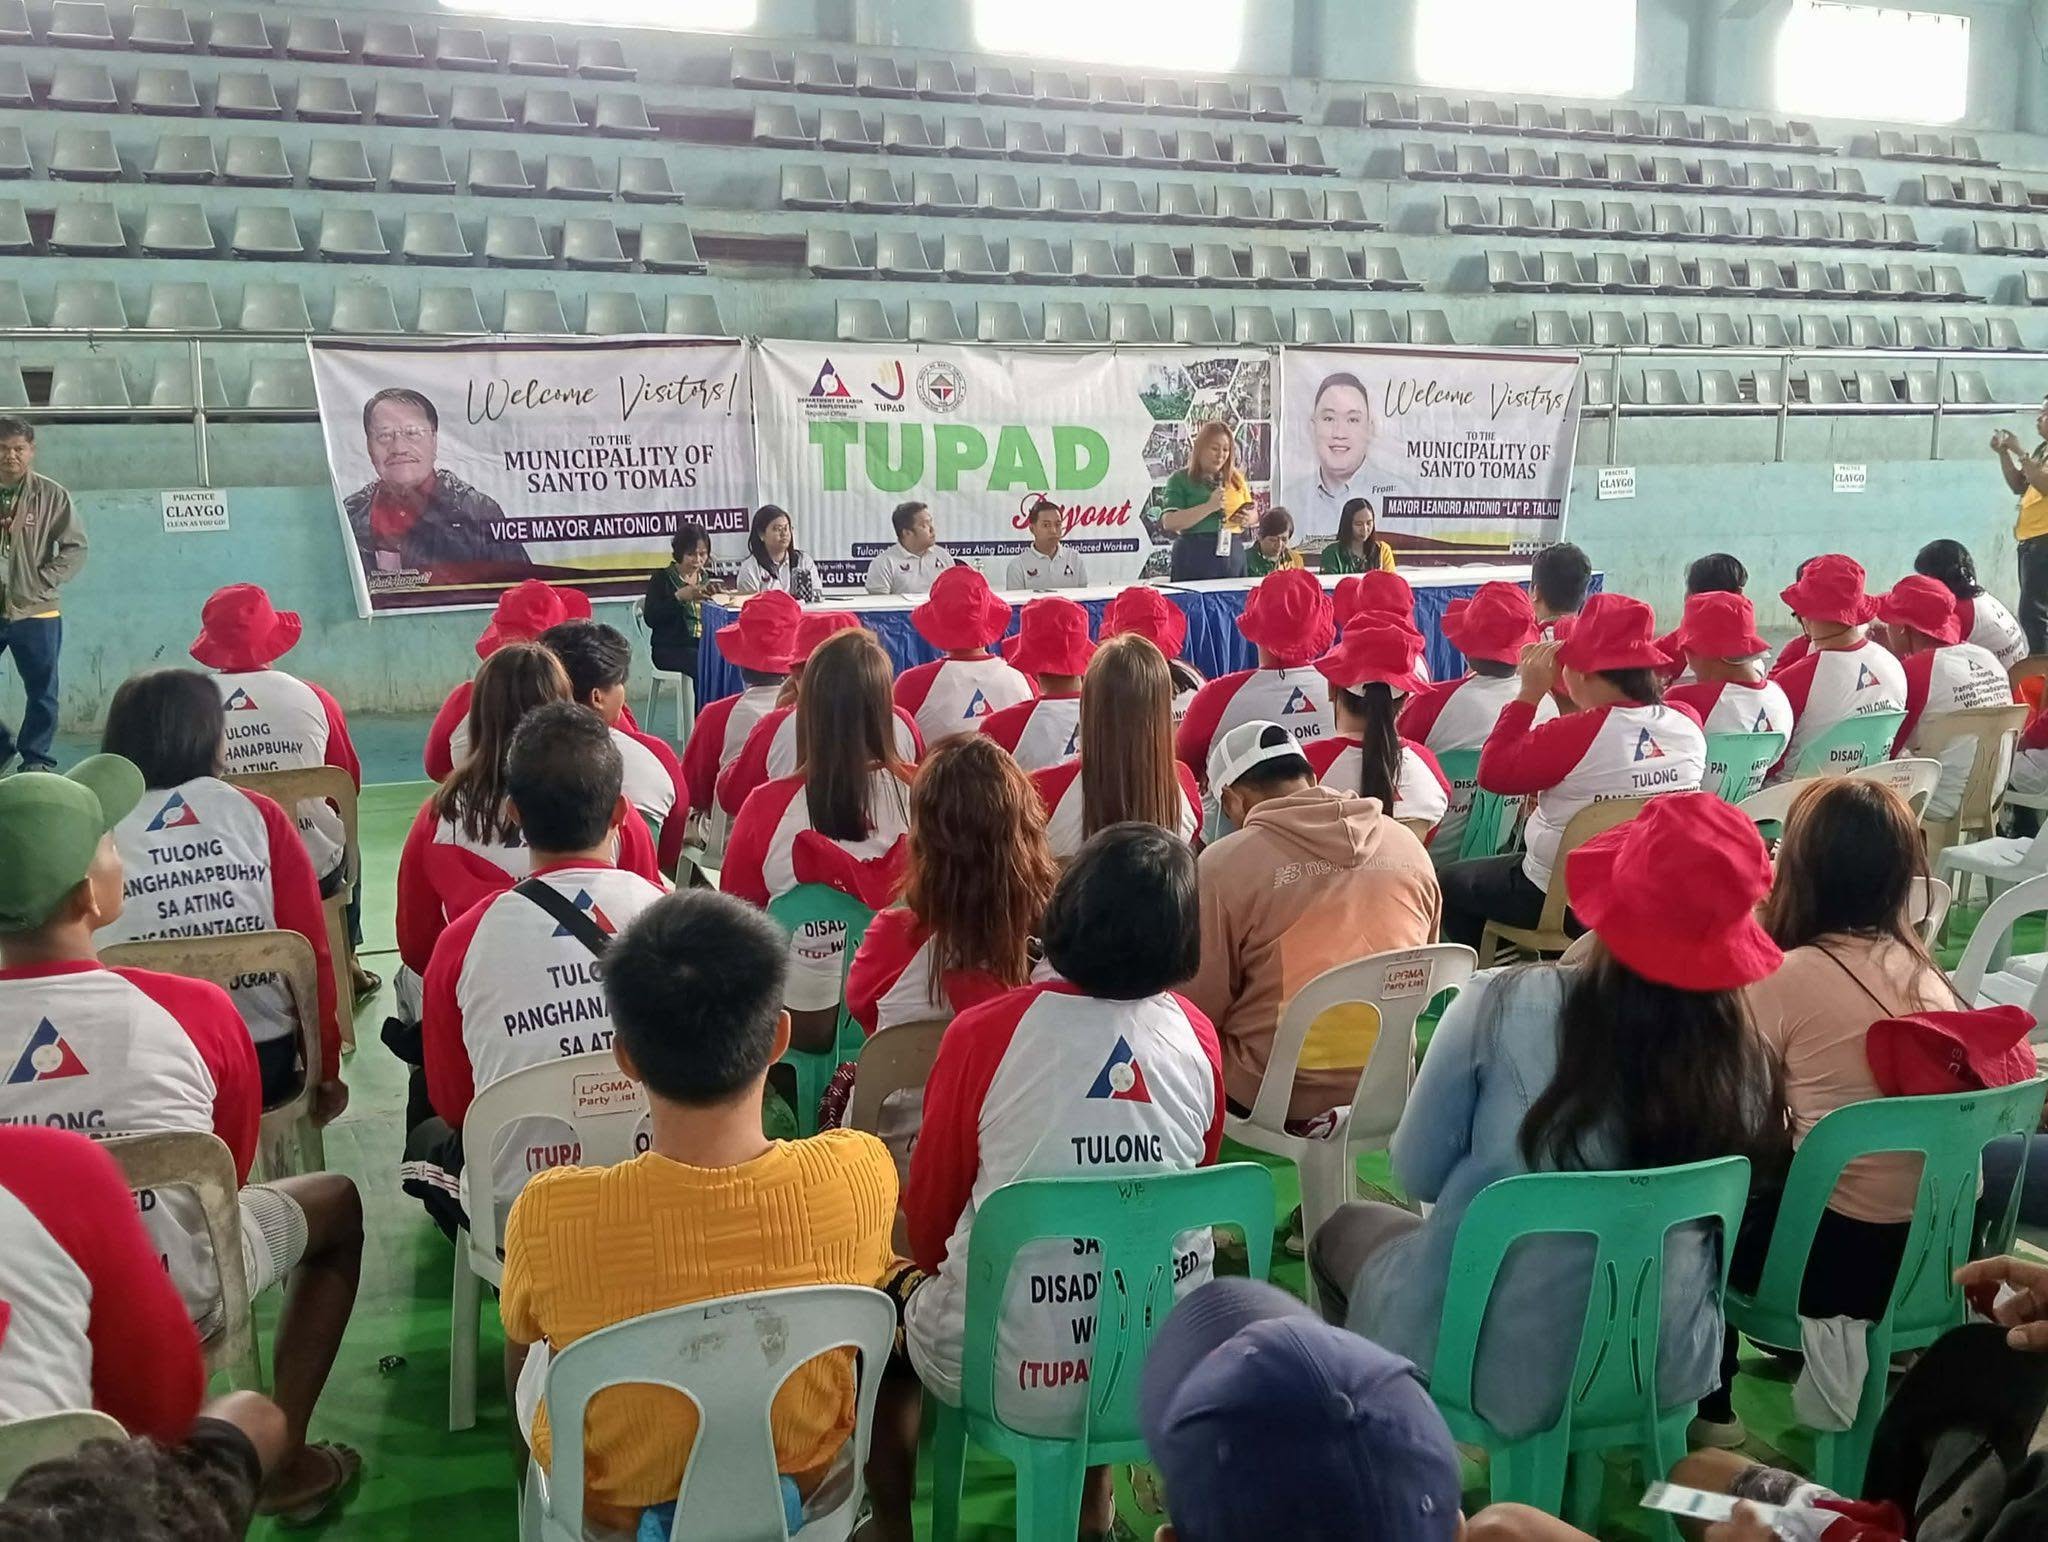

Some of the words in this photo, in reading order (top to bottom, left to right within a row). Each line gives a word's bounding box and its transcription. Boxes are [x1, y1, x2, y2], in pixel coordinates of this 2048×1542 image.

[466, 379, 598, 425] Welcome
[620, 373, 738, 421] Visitors!
[874, 403, 905, 412] TUPAD
[1384, 378, 1475, 418] Welcome
[1491, 381, 1574, 422] Visitors!
[588, 435, 605, 447] TO
[607, 434, 632, 446] THE
[1466, 431, 1477, 441] TO
[1479, 431, 1496, 441] THE
[504, 446, 678, 471] MUNICIPALITY
[684, 444, 714, 465] OF
[809, 421, 1110, 493] TUPAD
[1406, 441, 1527, 461] MUNICIPALITY
[1530, 444, 1551, 461] OF
[528, 470, 608, 493] SANTO
[614, 467, 697, 490] TOMAS
[1419, 460, 1475, 478] SANTO
[1479, 462, 1537, 480] TOMAS
[1835, 474, 1865, 482] CLAYGO
[1371, 484, 1396, 494] From:
[1600, 479, 1633, 488] CLAYGO
[173, 493, 215, 501] PRACTICE
[166, 505, 224, 518] CLAYGO
[1389, 499, 1419, 514] MAYOR
[1421, 500, 1461, 514] LEANDRO
[1463, 500, 1500, 515] ANTONIO
[1523, 502, 1530, 515] P.
[1532, 502, 1559, 516] TALAU
[490, 520, 529, 541] VICE
[531, 517, 590, 540] MAYOR
[593, 515, 662, 537] ANTONIO
[962, 547, 972, 555] sa
[973, 545, 996, 556] Ating
[1102, 542, 1134, 552] Workers
[845, 562, 856, 570] the
[822, 572, 844, 584] LGU
[225, 723, 271, 740] ULONG
[225, 741, 303, 760] HANAPBUHAY
[1632, 768, 1678, 788] TULONG
[148, 839, 223, 865] TULONG
[122, 864, 266, 901] ANGHANAPBUHAY
[157, 899, 180, 919] SA
[184, 890, 235, 916] ATING
[547, 961, 603, 988] TULO
[503, 996, 608, 1037] PANGHAN
[560, 1035, 585, 1057] SA
[582, 1080, 633, 1095] LPGMA
[579, 1096, 610, 1106] Party
[526, 1142, 582, 1172] (TUPA
[1071, 1134, 1164, 1165] TULONG
[1019, 1357, 1093, 1389] (TUPA
